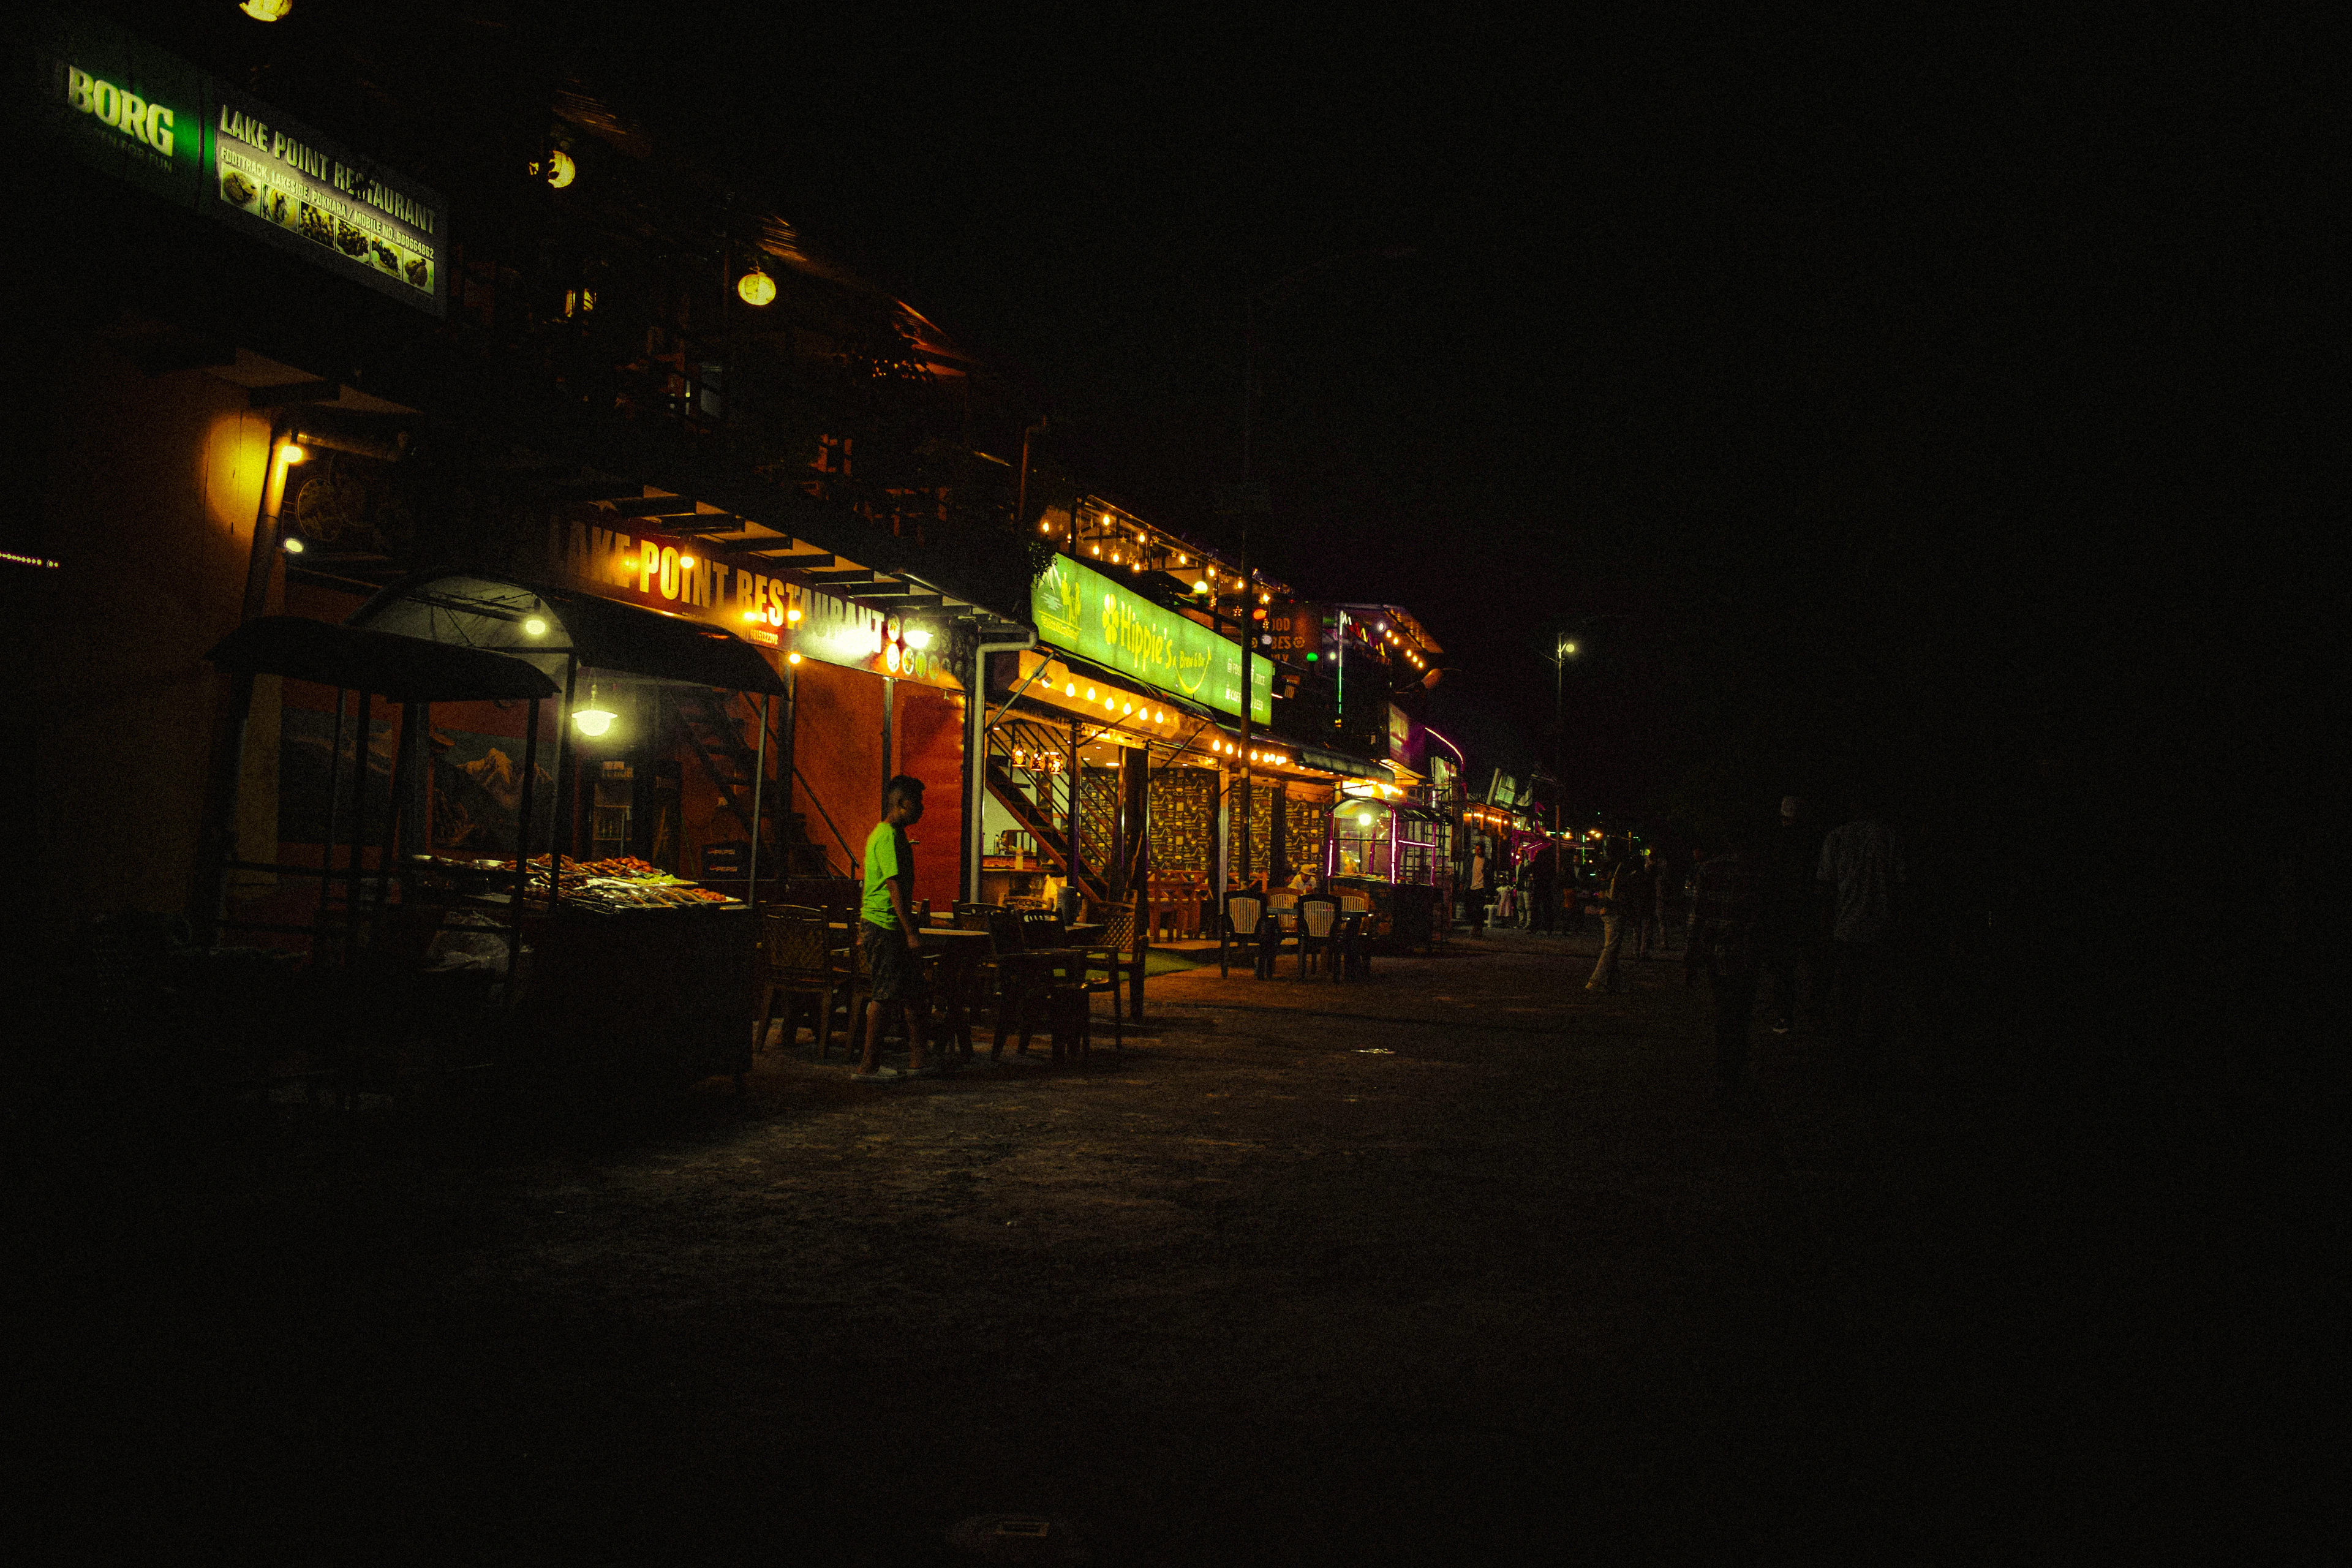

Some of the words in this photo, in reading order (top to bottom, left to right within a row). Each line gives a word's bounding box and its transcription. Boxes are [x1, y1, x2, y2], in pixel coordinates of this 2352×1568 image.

[67, 64, 174, 157] BORG
[221, 104, 268, 153] LAKE
[275, 131, 329, 181] POINT
[221, 146, 270, 183] FOOTTRACK,
[272, 172, 311, 202] LAKESIDE,
[312, 190, 347, 218] POKHARA
[354, 210, 382, 233] MOBILE
[382, 224, 395, 241] NO.
[639, 540, 729, 611] POINT
[736, 568, 885, 654] RESTAURANT
[1120, 601, 1173, 672] Hippie's
[1233, 663, 1242, 676] FOO
[1231, 690, 1242, 704] COFF
